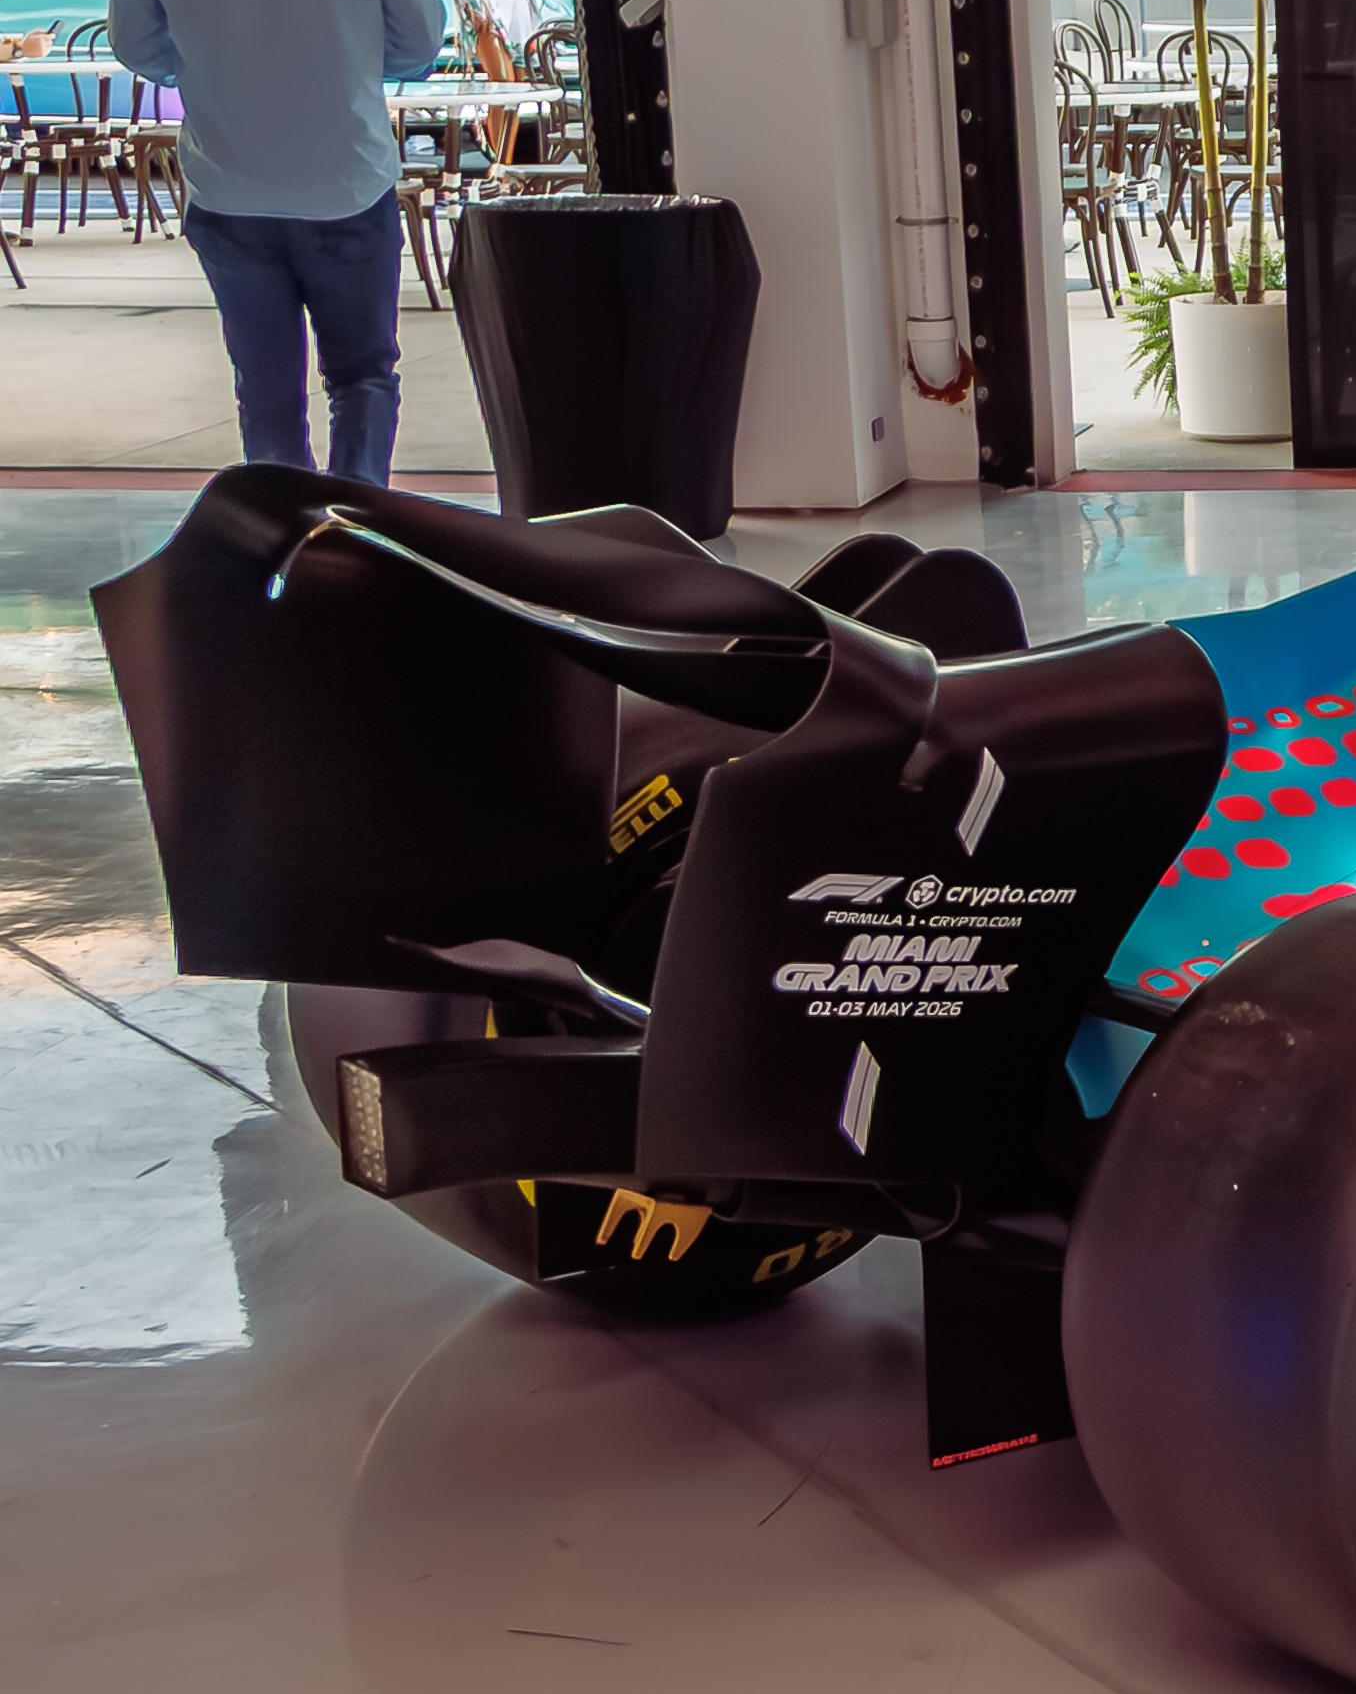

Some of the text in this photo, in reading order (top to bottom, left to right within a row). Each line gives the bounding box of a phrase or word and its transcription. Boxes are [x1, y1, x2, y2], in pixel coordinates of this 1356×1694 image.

[946, 884, 1077, 906] crypto.com
[825, 911, 1022, 928] FORMULA 1 CRYPTO.COM
[842, 934, 982, 962] MIAMI
[774, 963, 1019, 993] GRAND PRIX
[808, 1001, 964, 1017] 01-03 MAY 2026
